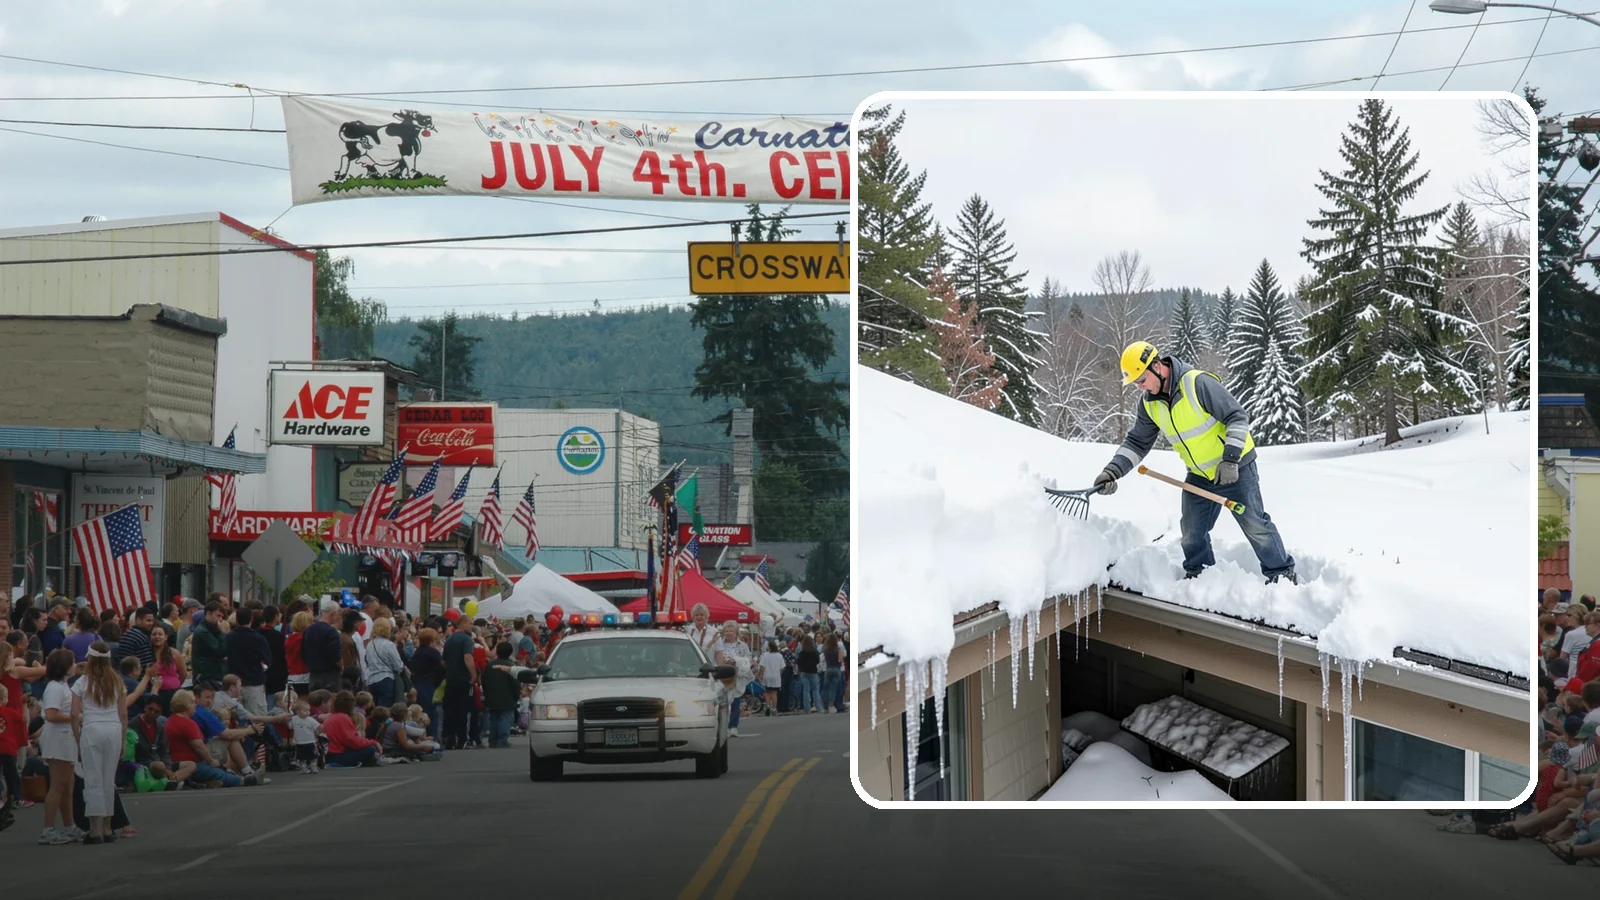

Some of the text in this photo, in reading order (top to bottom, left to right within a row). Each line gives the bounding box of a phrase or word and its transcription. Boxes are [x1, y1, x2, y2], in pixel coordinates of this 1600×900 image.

[481, 141, 605, 192] JULY
[632, 150, 746, 197] 4th.
[697, 254, 850, 280] CROSSWA
[282, 380, 373, 419] ACE
[406, 409, 485, 421] CEDAR LOG
[283, 421, 370, 436] Hardware
[416, 428, 476, 446] Coca-Cola
[354, 467, 385, 480] Simpl
[96, 485, 124, 494] Vincent
[126, 486, 136, 495] de
[137, 486, 155, 495] Paul
[81, 503, 154, 522] THT
[688, 526, 741, 535] CRNATION
[699, 535, 730, 543] GLASS
